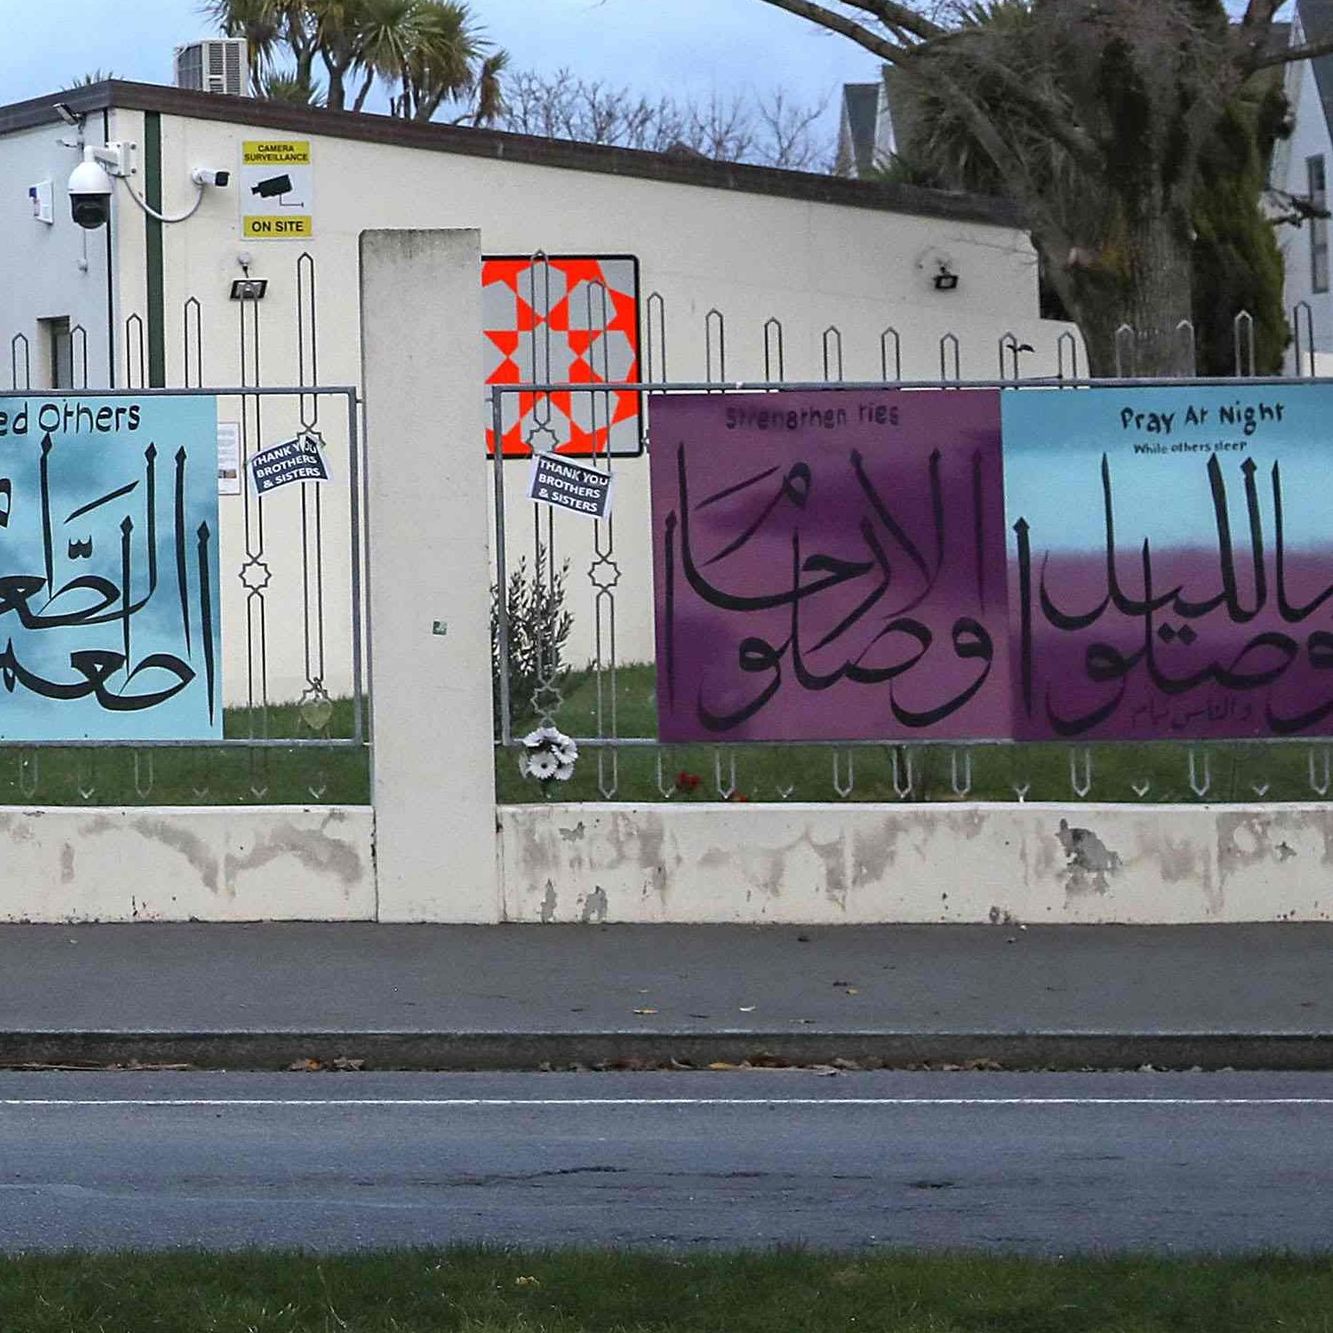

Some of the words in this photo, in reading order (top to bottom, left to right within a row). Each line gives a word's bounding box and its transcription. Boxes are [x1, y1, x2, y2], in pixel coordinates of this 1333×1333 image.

[244, 153, 309, 162] SURVEILLANCE
[257, 144, 295, 153] CAMERA
[251, 221, 272, 232] ON
[275, 221, 304, 232] SITE
[38, 399, 141, 434] Others
[1120, 406, 1176, 434] Pray
[1218, 400, 1285, 436] Night
[253, 446, 292, 467] THANK
[1134, 442, 1168, 454] While
[1171, 440, 1211, 452] others
[256, 454, 318, 478] BROTHERS
[539, 459, 581, 482] THANK
[583, 471, 608, 486] YOU
[263, 479, 273, 489] &
[275, 467, 321, 485] SISTERS
[538, 473, 602, 499] BROTHERS
[538, 488, 549, 499] &
[551, 491, 598, 513] SISTERS
